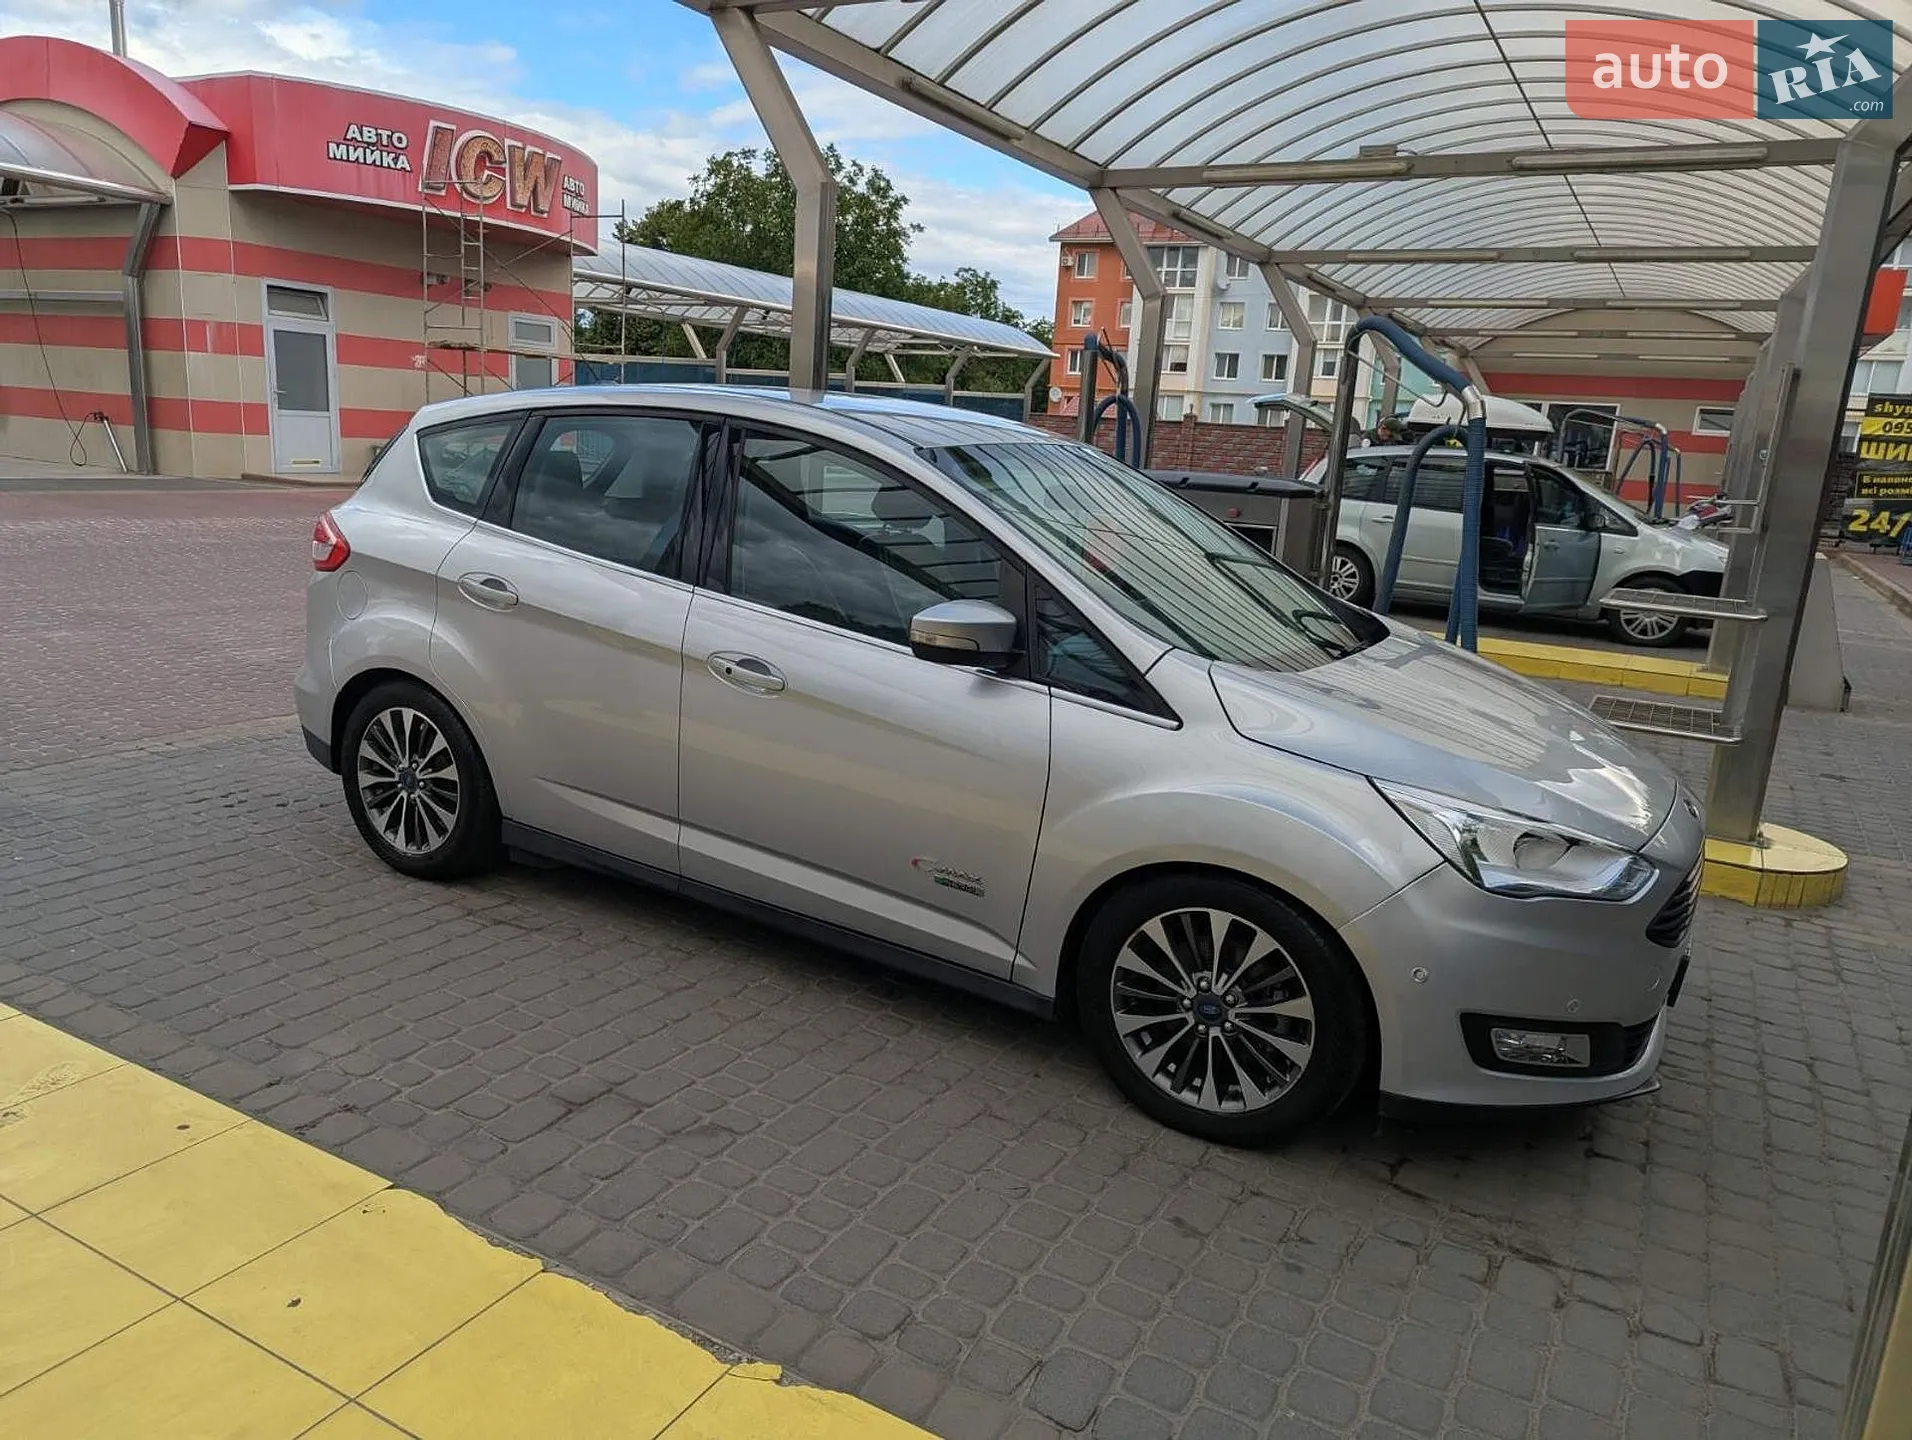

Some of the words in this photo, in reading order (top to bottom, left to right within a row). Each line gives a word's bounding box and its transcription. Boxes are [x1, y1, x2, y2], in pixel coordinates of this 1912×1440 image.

[345, 123, 408, 149] АВТО
[327, 142, 411, 172] МИЙКА
[419, 119, 561, 217] ICW
[563, 174, 585, 196] АВТО
[1882, 420, 1912, 434] 095
